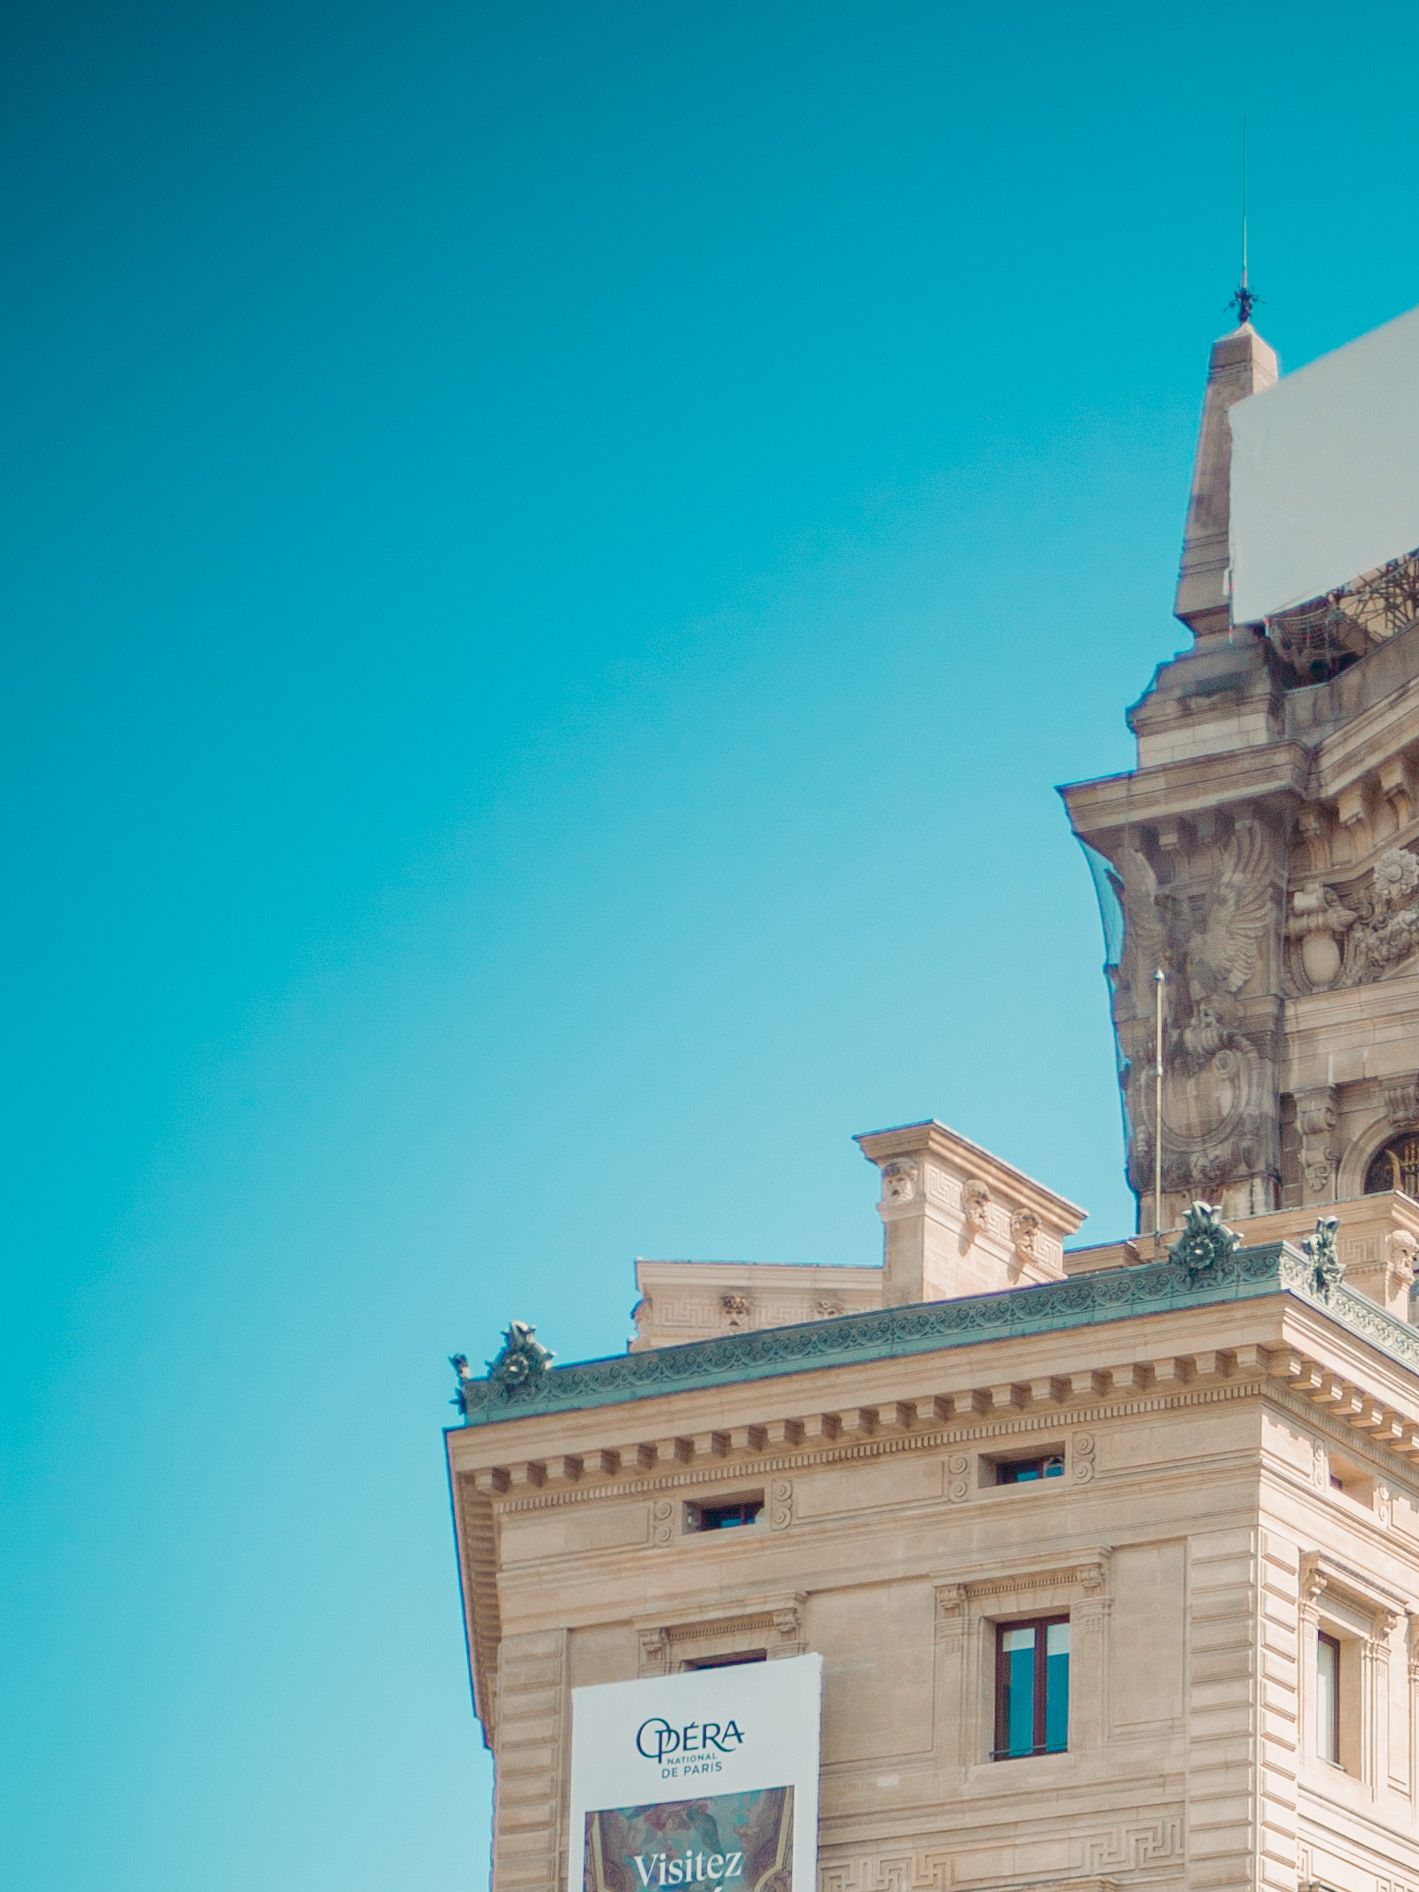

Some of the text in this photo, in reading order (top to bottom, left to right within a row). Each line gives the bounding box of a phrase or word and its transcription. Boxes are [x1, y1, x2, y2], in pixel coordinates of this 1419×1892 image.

[636, 1717, 745, 1764] OPÉRA
[661, 1761, 722, 1779] DE PARIS
[667, 1752, 717, 1765] NATIONAL
[634, 1849, 742, 1887] Visitez
